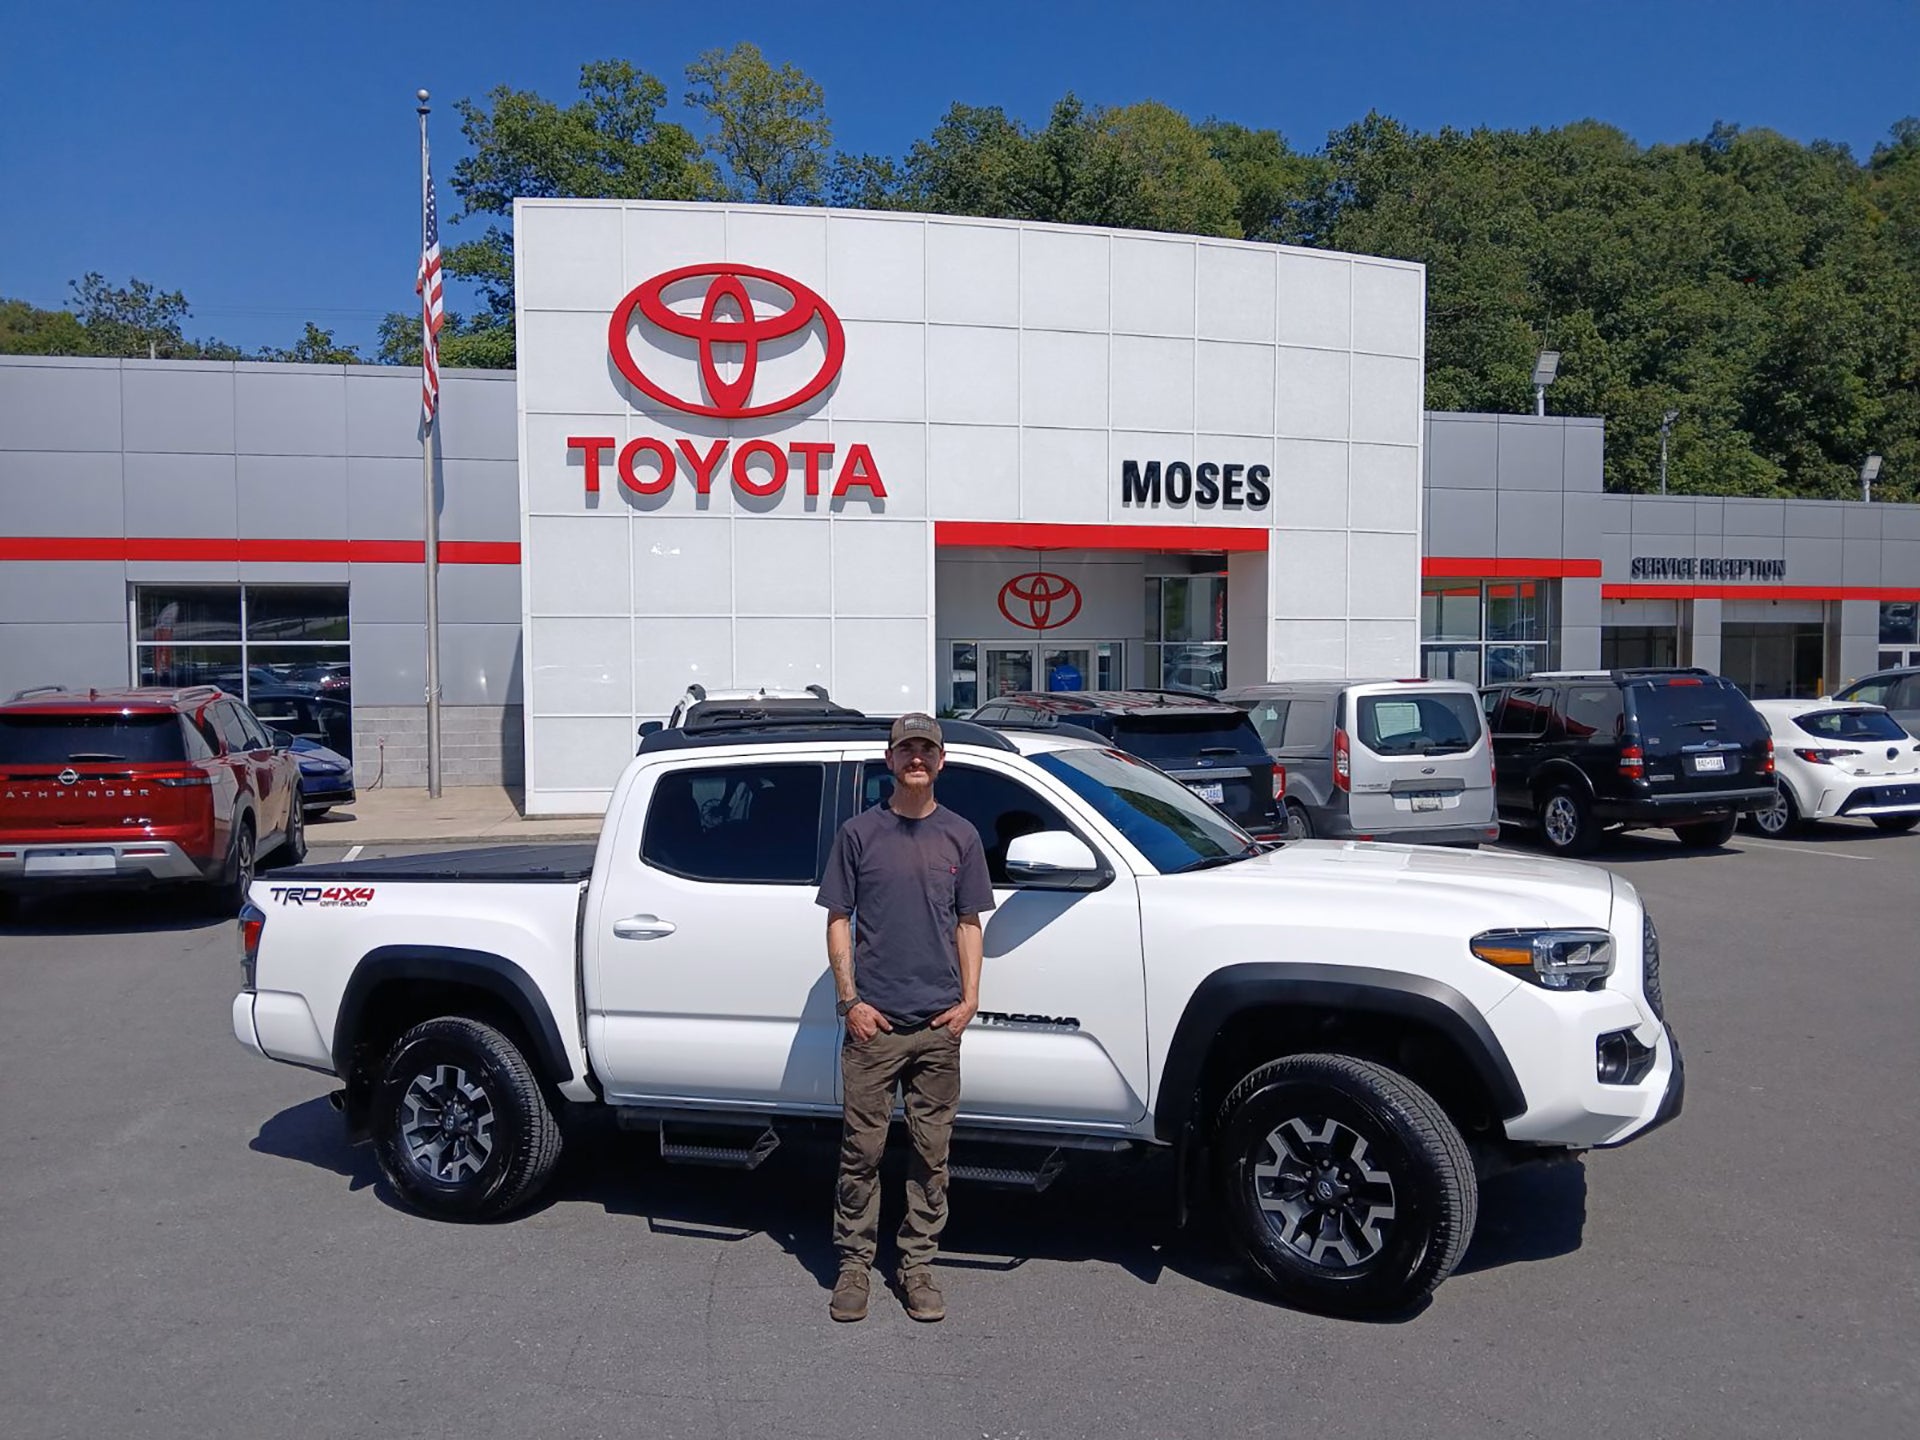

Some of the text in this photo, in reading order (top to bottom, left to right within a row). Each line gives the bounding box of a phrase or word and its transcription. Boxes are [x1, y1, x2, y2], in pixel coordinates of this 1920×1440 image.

[567, 436, 888, 498] TOYOTA
[1122, 460, 1271, 506] MOSES
[1631, 557, 1787, 580] SERVICE RECEPTION
[976, 1011, 1081, 1028] TACOMA
